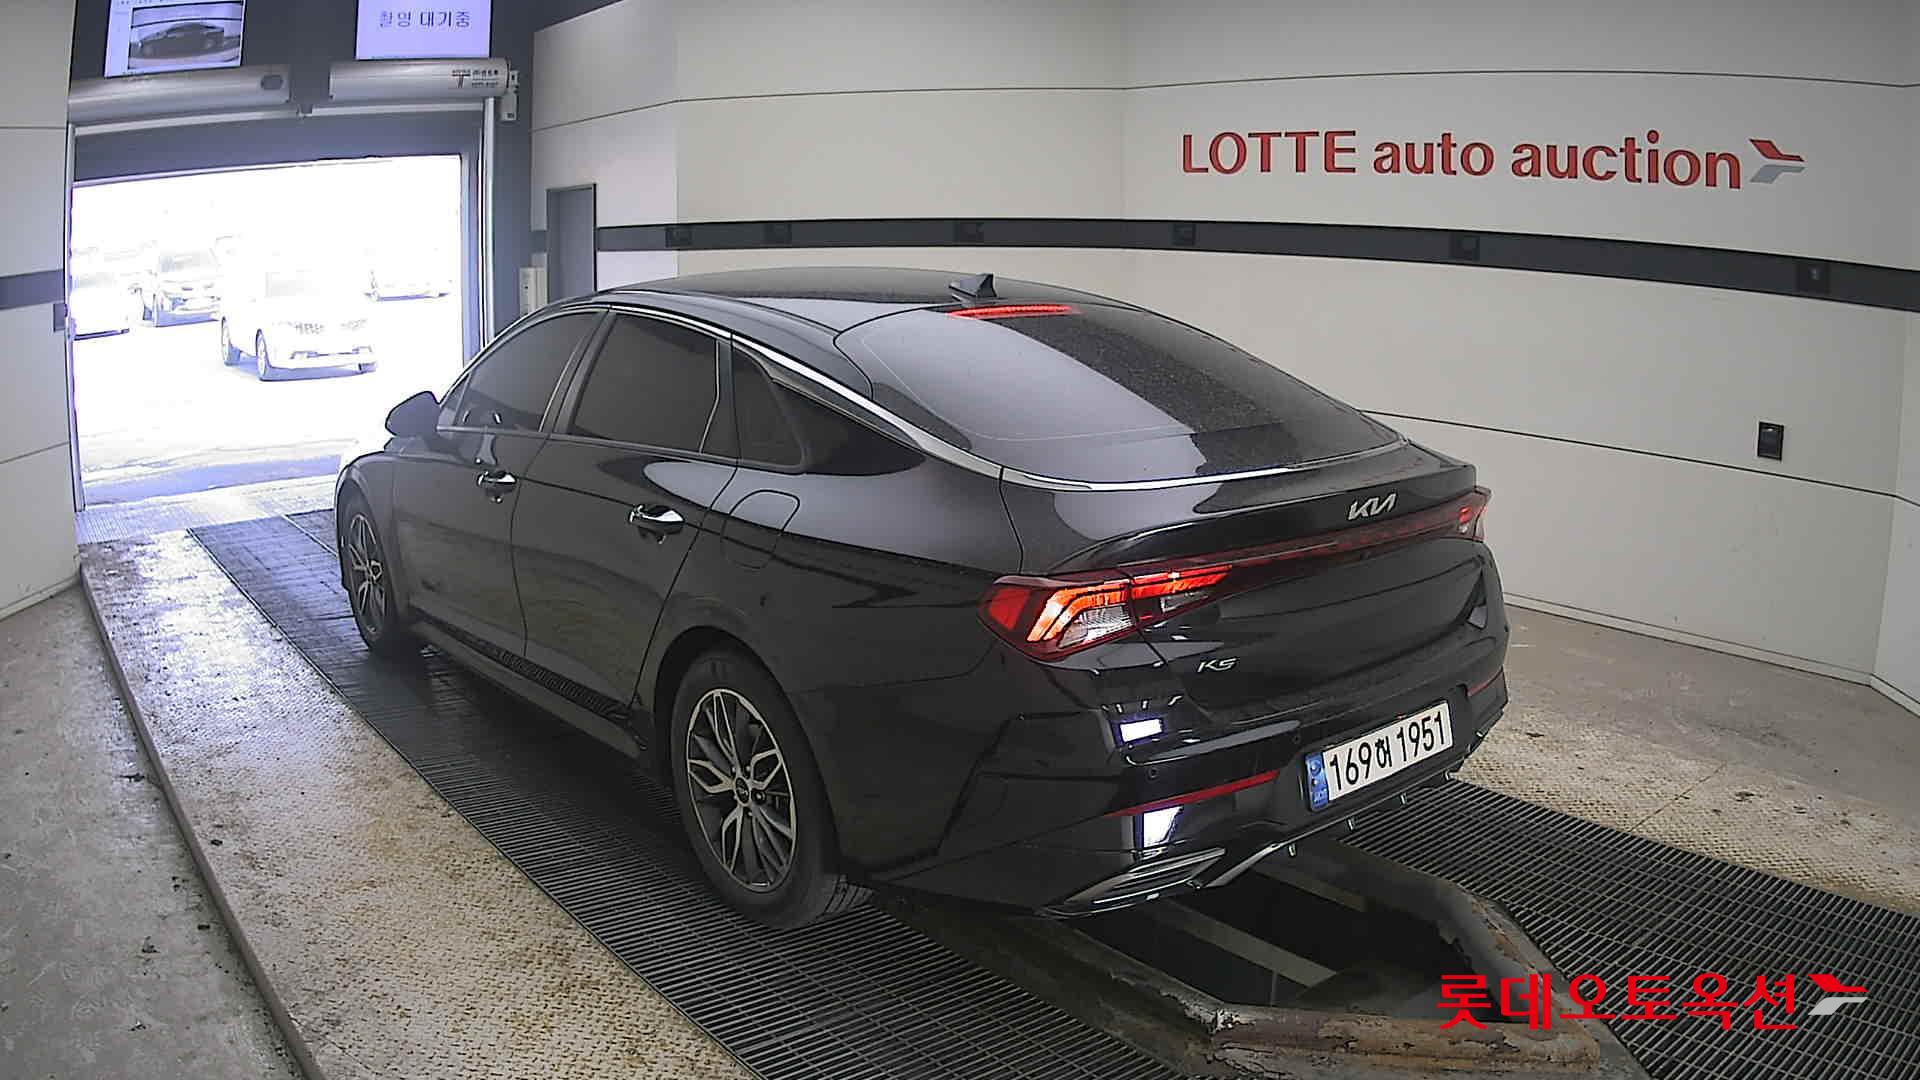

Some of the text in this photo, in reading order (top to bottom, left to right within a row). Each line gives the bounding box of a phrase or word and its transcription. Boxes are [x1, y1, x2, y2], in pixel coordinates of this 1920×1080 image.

[419, 10, 471, 28] 대기중
[1181, 129, 1741, 189] LOTTE auto auction
[1347, 493, 1397, 521] KIA
[1196, 657, 1238, 673] K5
[1329, 710, 1445, 791] 169허 1951
